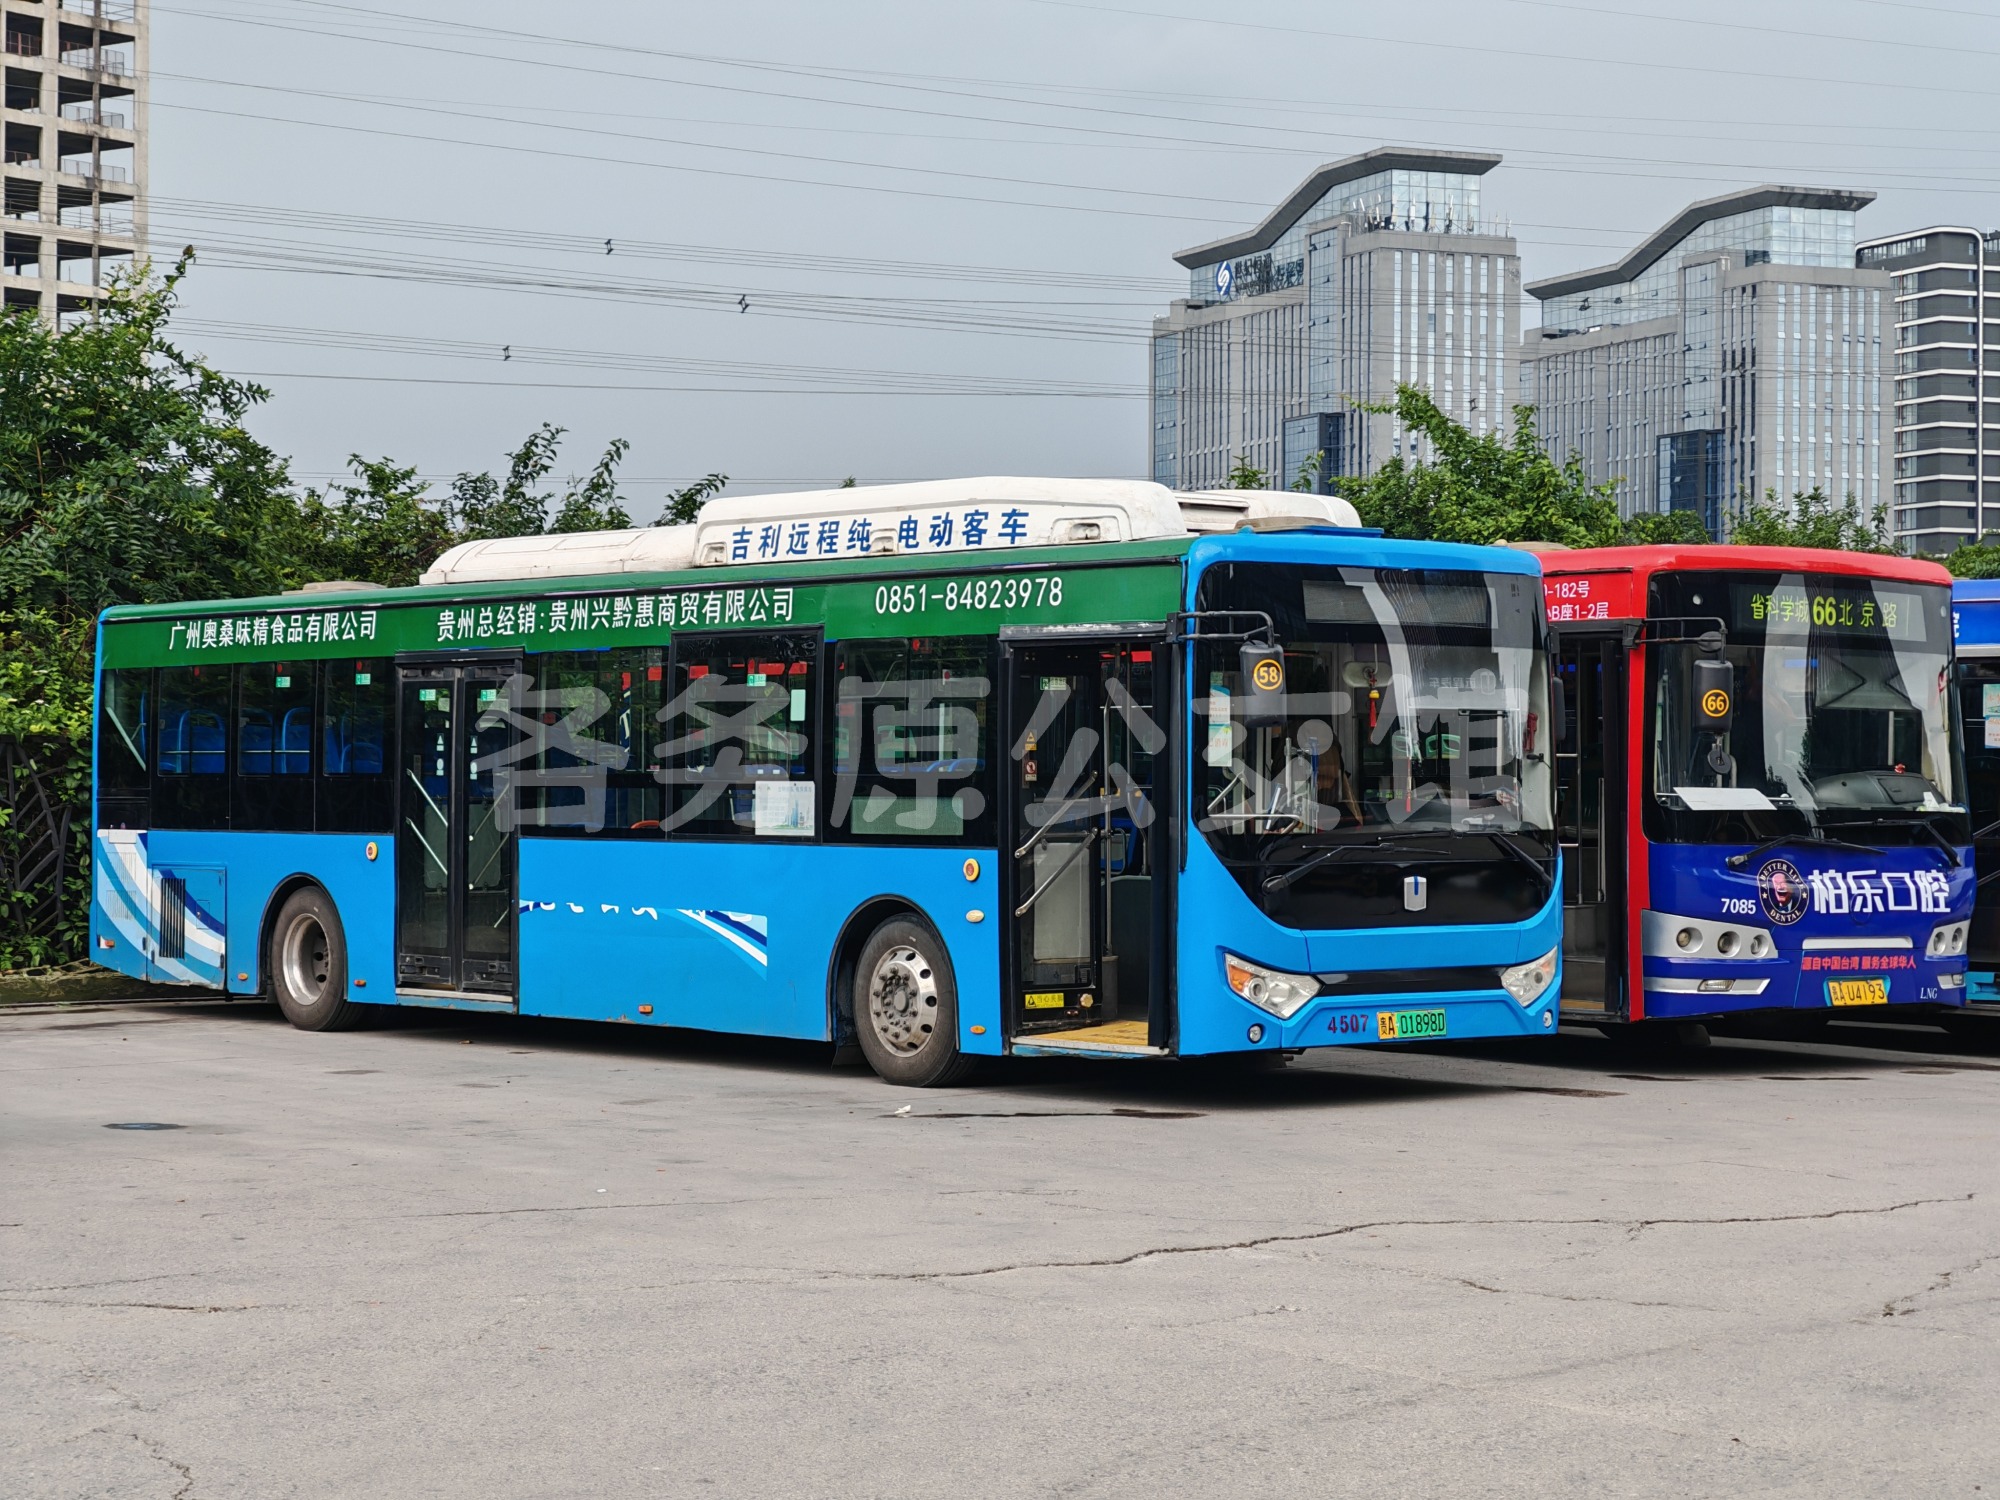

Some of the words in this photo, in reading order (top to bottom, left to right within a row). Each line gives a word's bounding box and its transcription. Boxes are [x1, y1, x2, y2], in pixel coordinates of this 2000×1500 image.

[732, 508, 1030, 560] 吉利远程纯电动客车
[875, 577, 1063, 615] 0851-84823978
[1751, 593, 1809, 623] 省科学城
[1813, 596, 1837, 626] 66
[1839, 599, 1898, 628] 北京路
[169, 610, 377, 650] 广州奥桑味精食品有限公司
[1259, 666, 1279, 684] 58
[1707, 695, 1725, 711] 66
[1760, 863, 1788, 881] BETTER
[1789, 869, 1806, 890] LIFE
[1808, 869, 1951, 914] 柏乐口腔
[1721, 898, 1756, 914] 7085
[1770, 909, 1801, 922] DENTAL
[1920, 987, 1938, 1000] LNG
[1327, 1014, 1369, 1034] 4507
